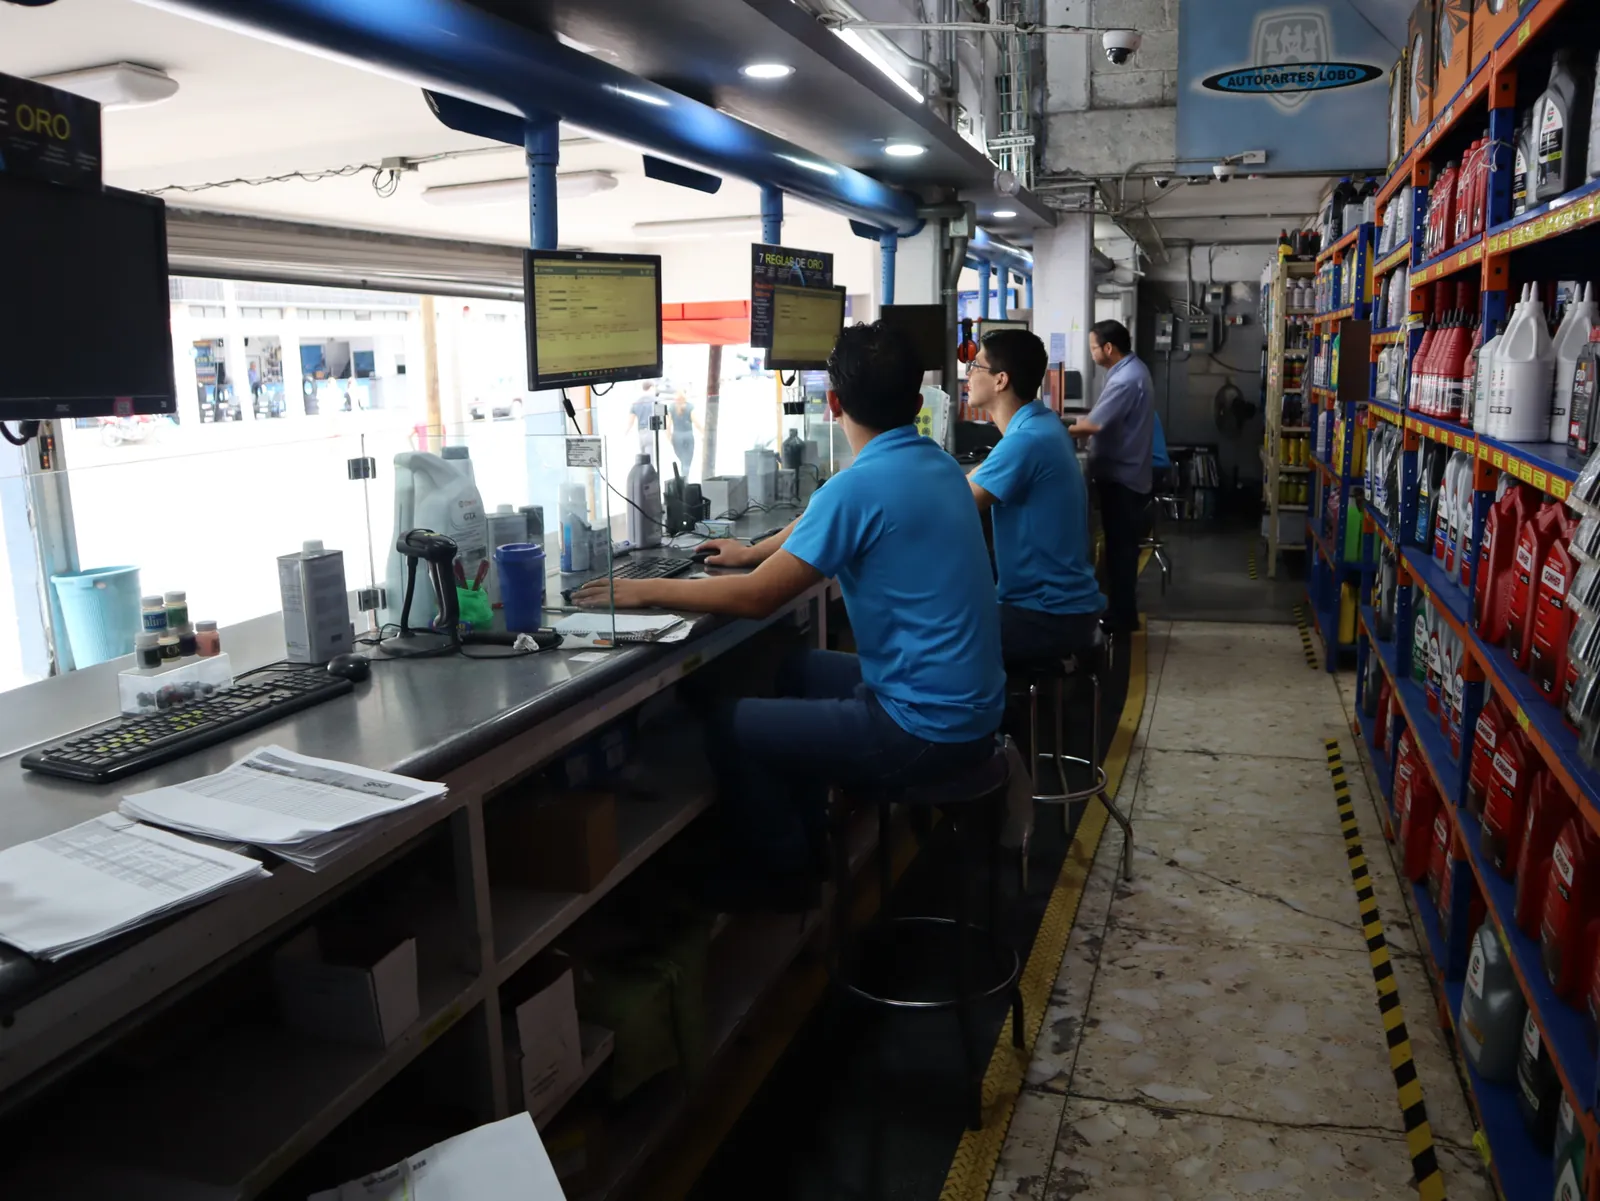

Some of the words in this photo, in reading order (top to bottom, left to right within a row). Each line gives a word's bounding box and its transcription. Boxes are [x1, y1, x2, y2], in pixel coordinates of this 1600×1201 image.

[1227, 71, 1315, 88] AUTOPARTES
[1319, 69, 1357, 82] LOBO
[15, 103, 71, 140] ORO
[759, 252, 764, 264] 7
[765, 253, 794, 267] REGLAS
[795, 257, 806, 269] DE
[807, 259, 824, 270] ORO
